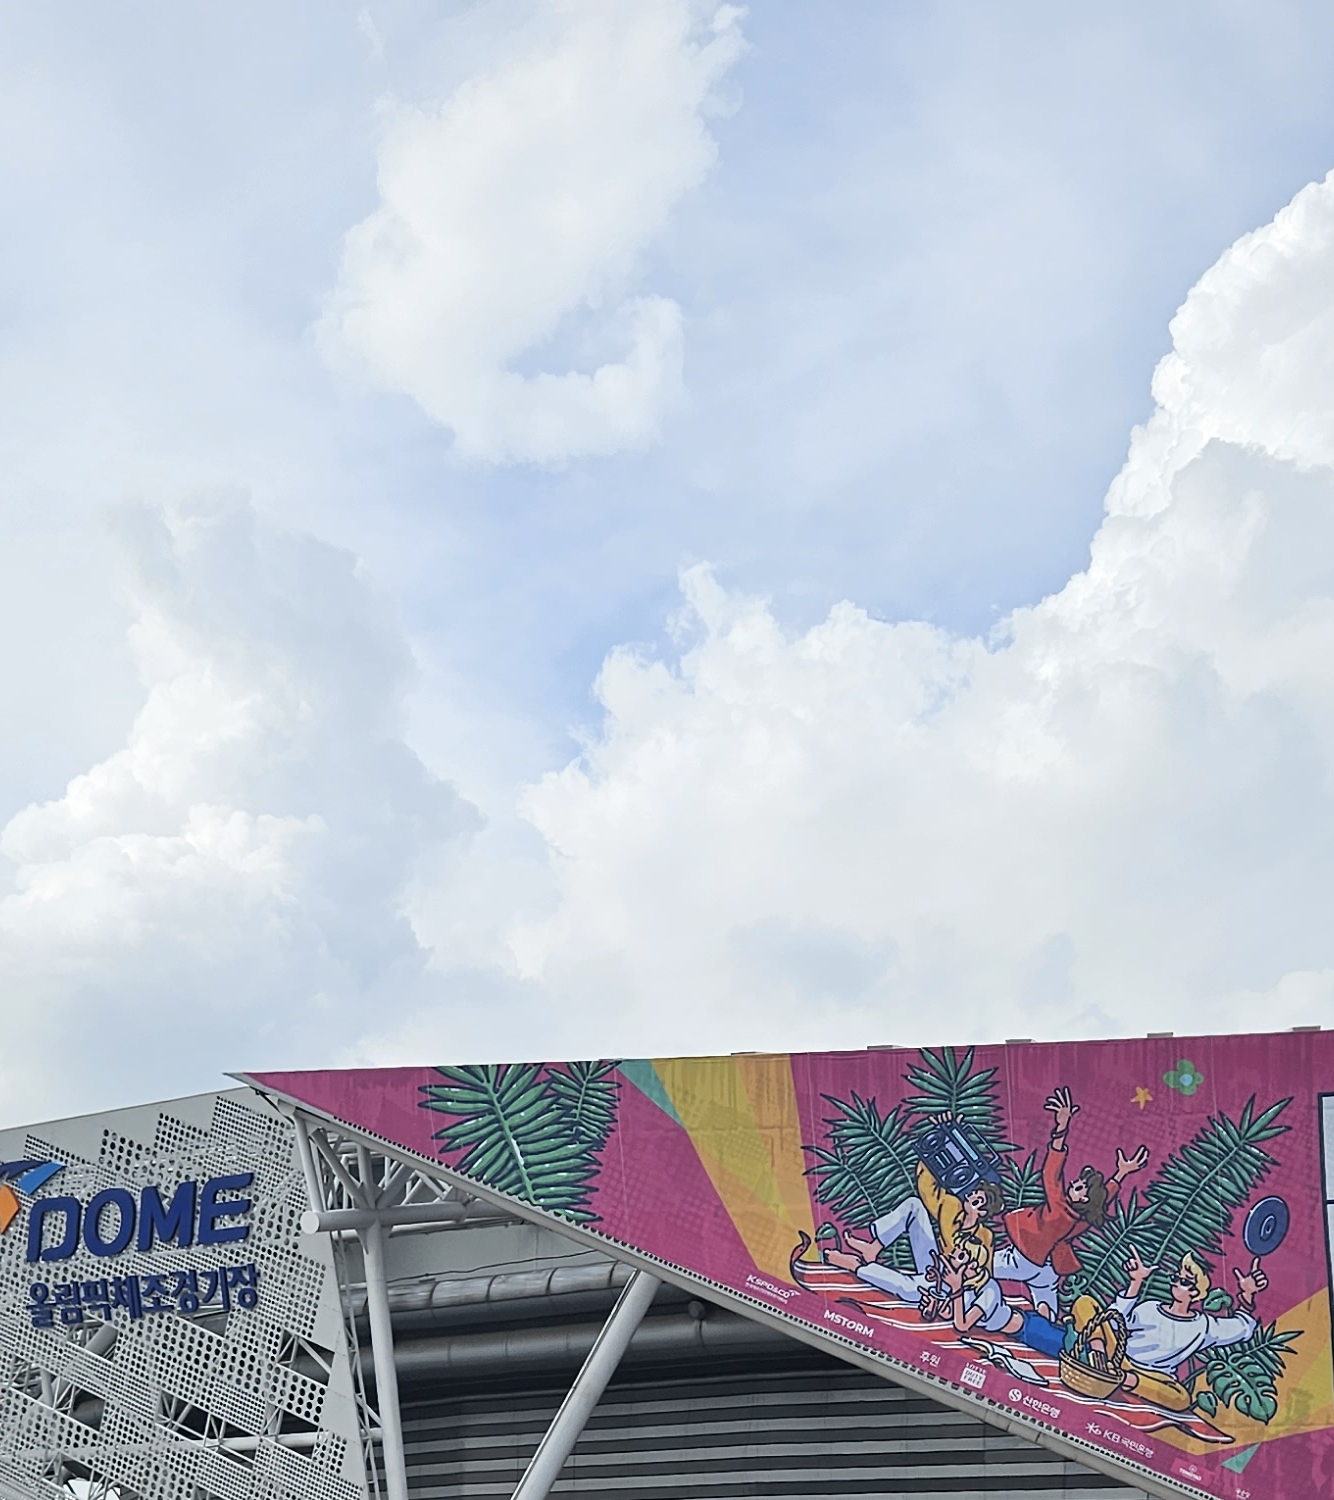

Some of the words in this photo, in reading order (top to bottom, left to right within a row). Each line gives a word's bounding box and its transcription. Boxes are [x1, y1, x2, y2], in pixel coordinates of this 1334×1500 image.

[26, 1171, 255, 1263] DOME
[26, 1262, 260, 1328] 올림픽체조경기장
[823, 1309, 875, 1338] MSTORM
[920, 1351, 942, 1368] 후원
[1022, 1395, 1061, 1419] 신한은행
[1103, 1429, 1121, 1444] KB
